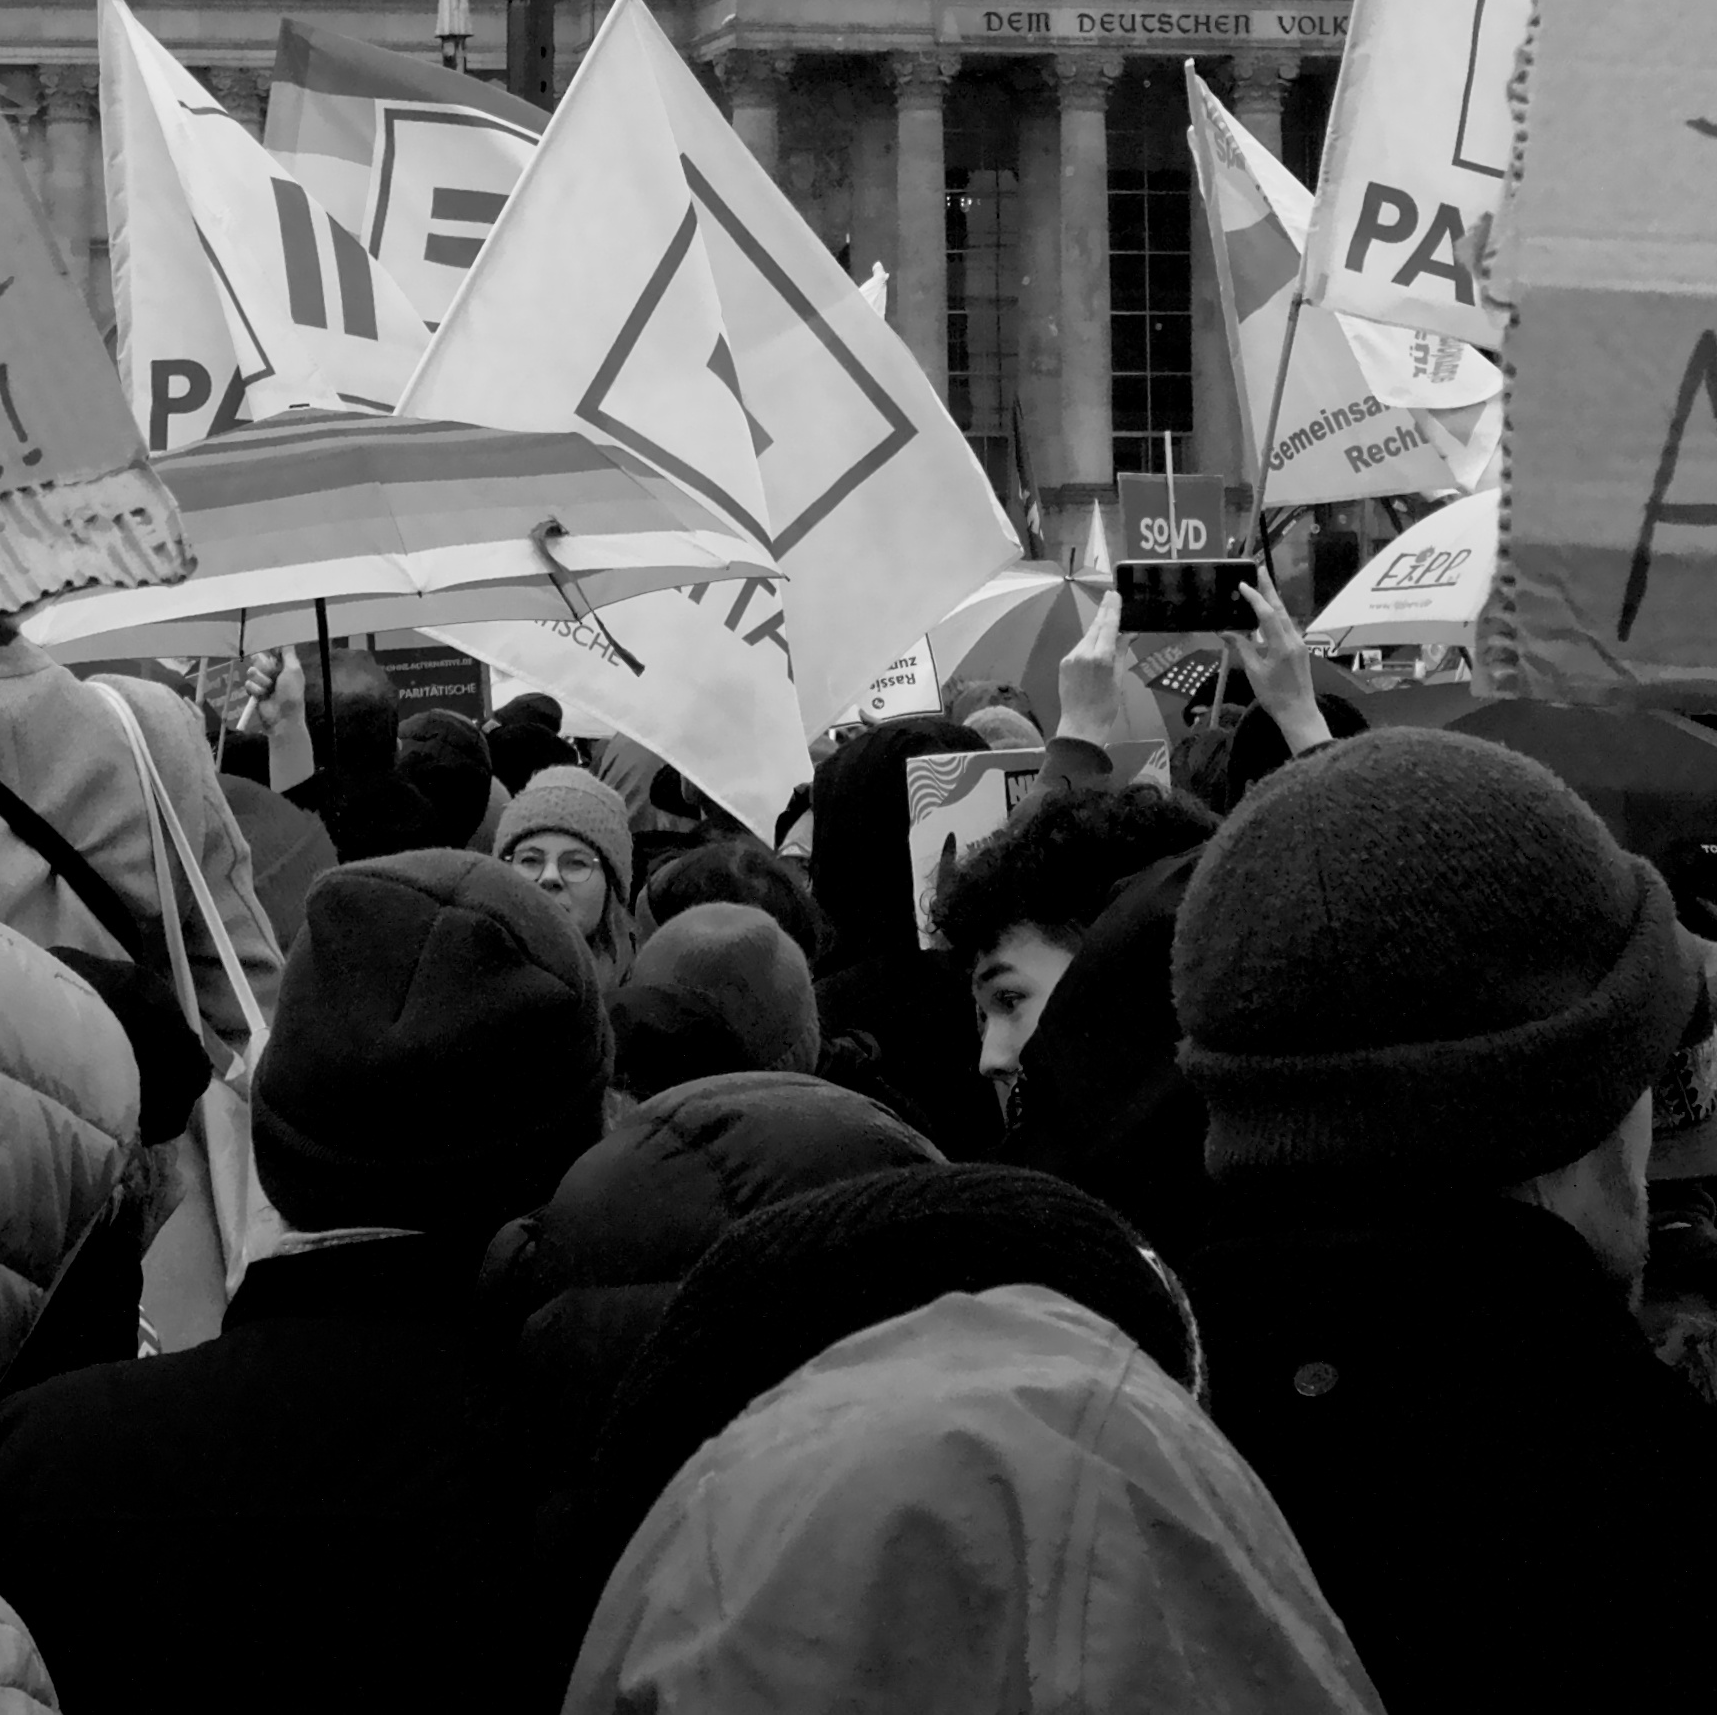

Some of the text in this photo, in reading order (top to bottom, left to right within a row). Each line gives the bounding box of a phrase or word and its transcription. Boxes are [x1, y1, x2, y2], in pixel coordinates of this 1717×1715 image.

[984, 11, 1051, 34] DEM
[1077, 13, 1251, 35] DEUTSCHEN
[1269, 395, 1391, 471] Gemeinsa
[399, 681, 477, 699] PARITÄTISCHE
